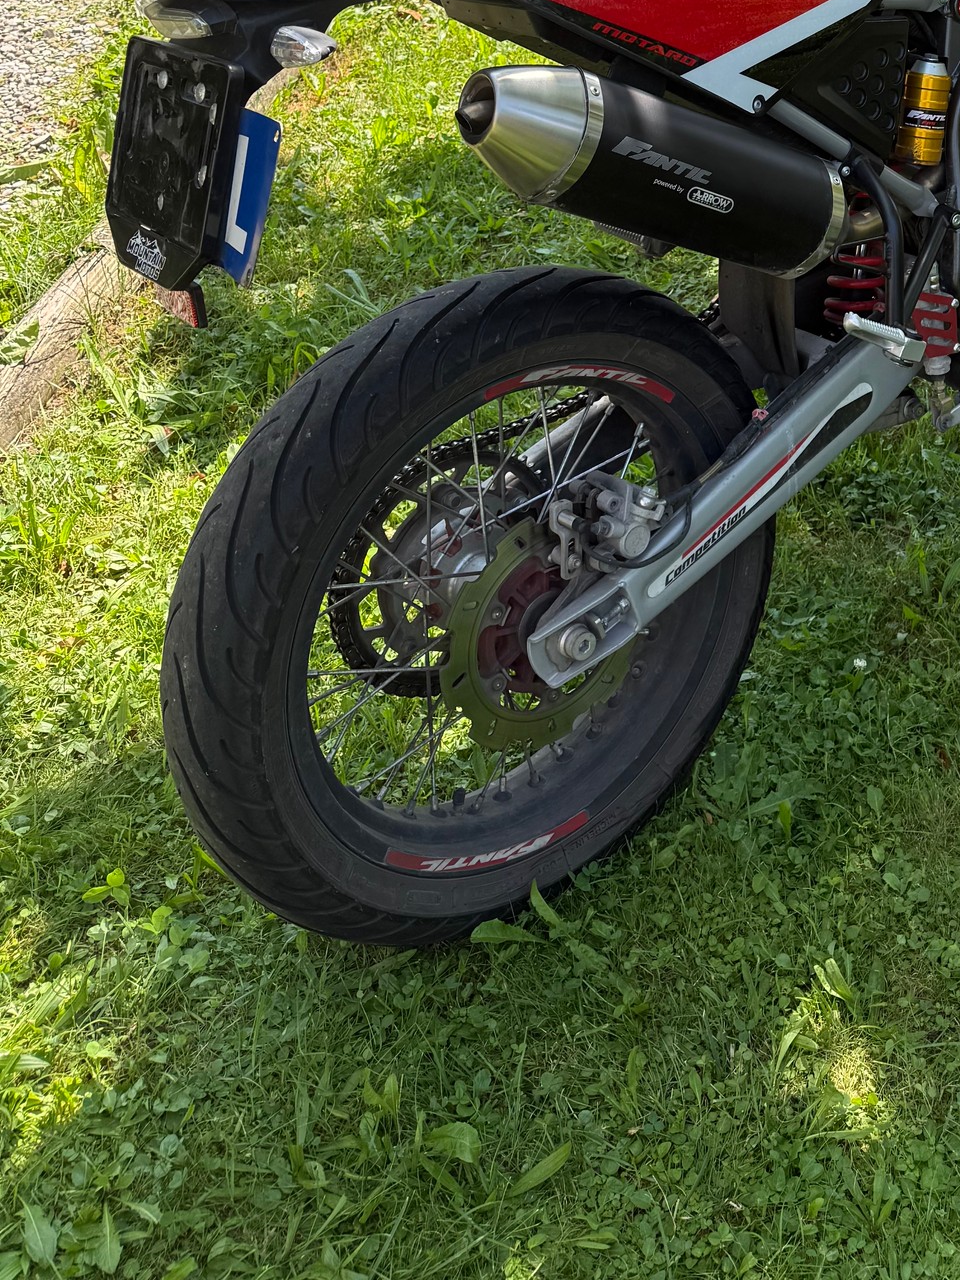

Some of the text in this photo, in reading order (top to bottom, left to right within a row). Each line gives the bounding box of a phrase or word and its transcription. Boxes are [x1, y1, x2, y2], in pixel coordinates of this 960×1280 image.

[592, 22, 698, 67] MOTARD
[611, 135, 713, 185] FANTIC
[225, 134, 250, 255] L
[652, 178, 685, 194] powered by
[692, 189, 731, 208] ARROW
[126, 239, 167, 270] MOUNTAIN
[135, 259, 161, 280] MOTOS
[520, 365, 648, 385] FANTIC
[665, 505, 747, 587] Competition
[420, 833, 555, 872] FANTIC
